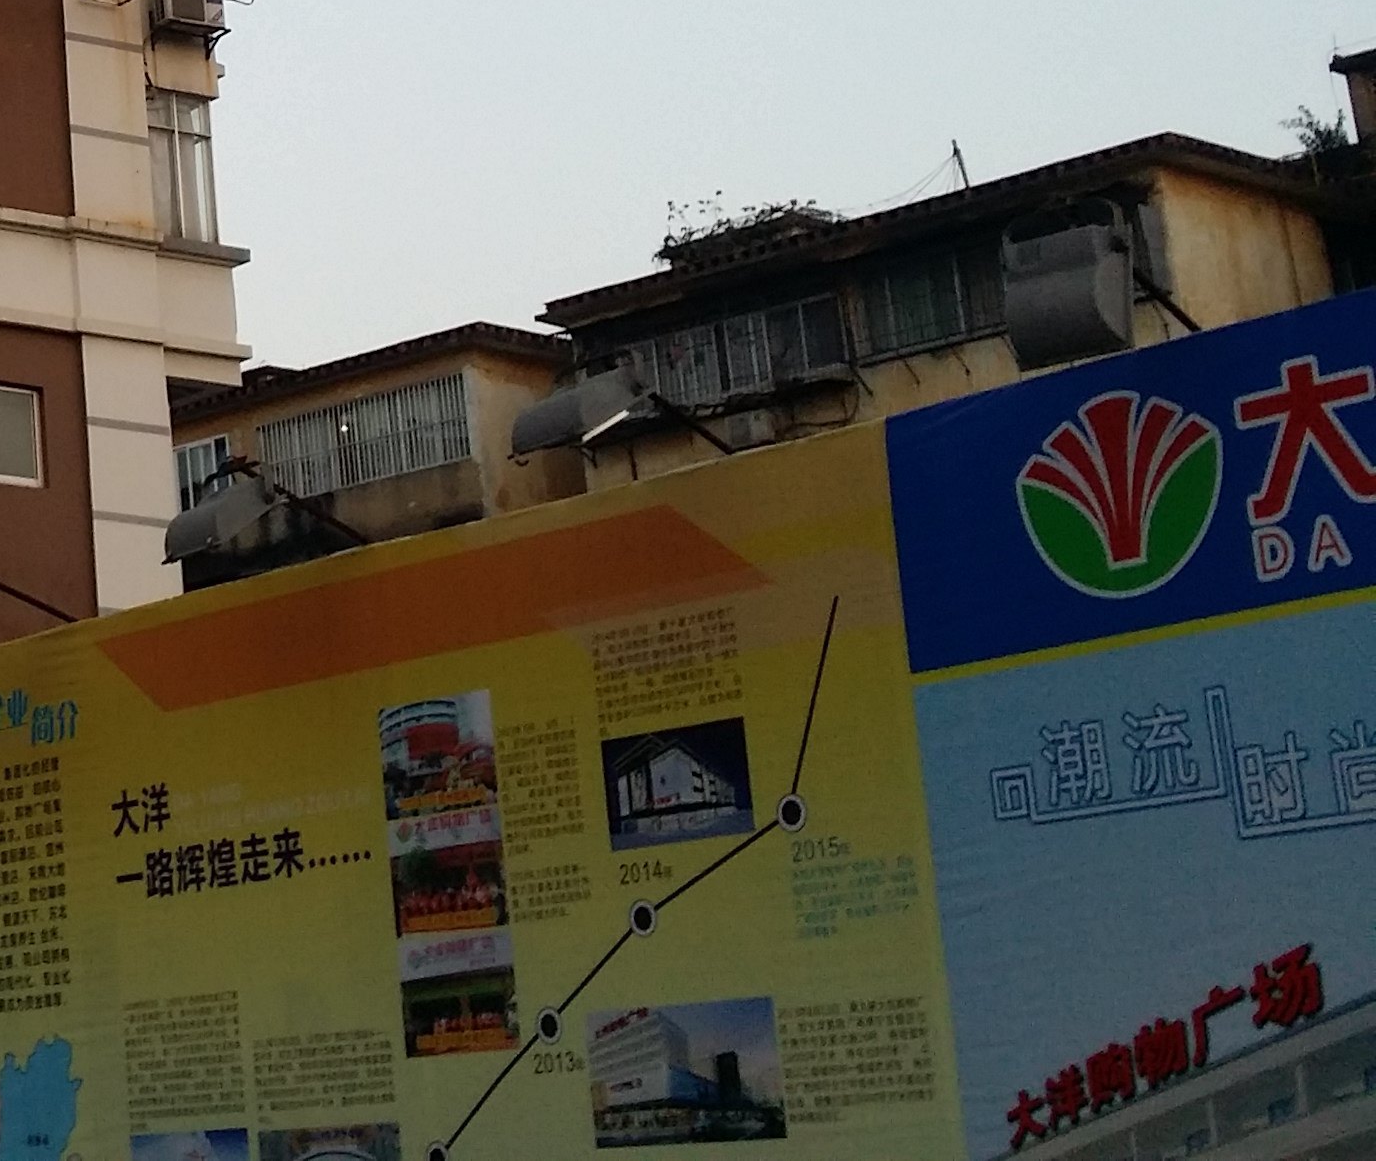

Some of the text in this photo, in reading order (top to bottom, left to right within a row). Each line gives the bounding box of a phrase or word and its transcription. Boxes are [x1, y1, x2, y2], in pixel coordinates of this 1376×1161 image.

[1251, 514, 1353, 583] DA
[111, 781, 171, 838] 大洋
[1006, 942, 1325, 1151] 大洋购物广场
